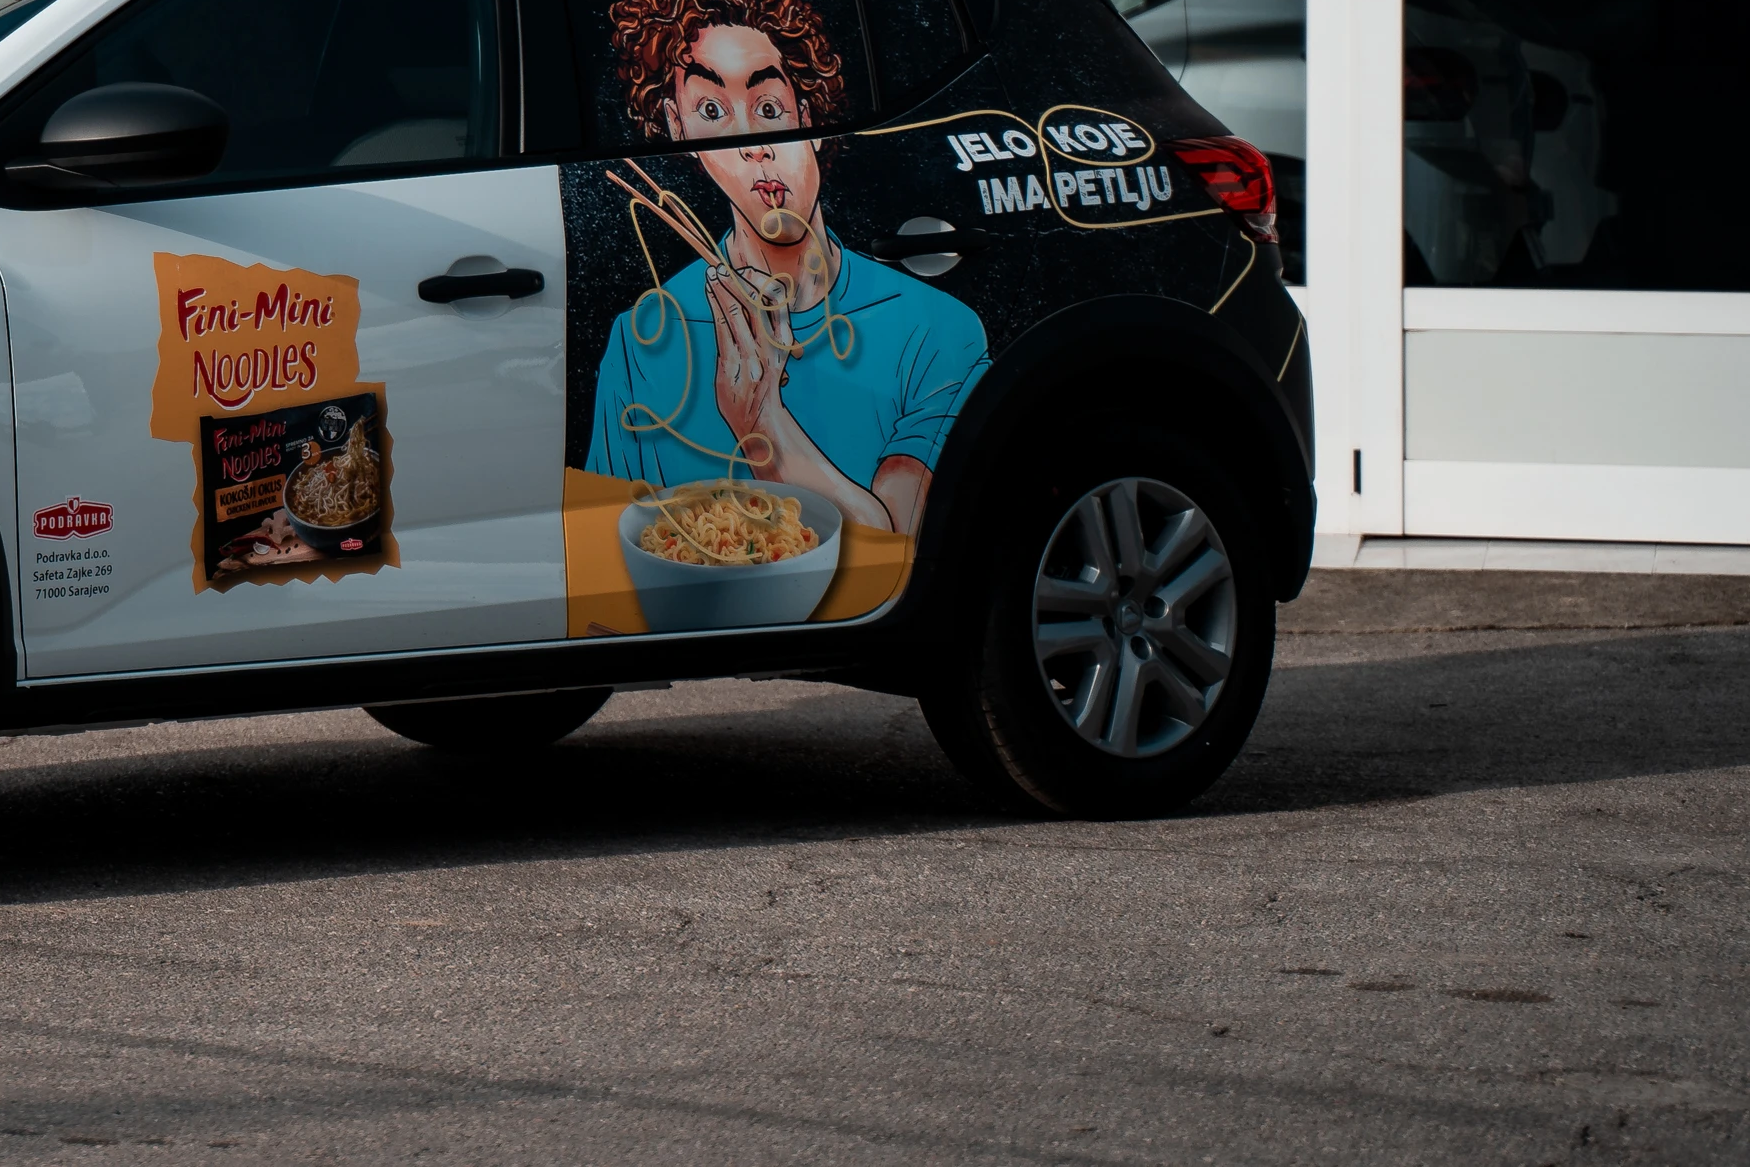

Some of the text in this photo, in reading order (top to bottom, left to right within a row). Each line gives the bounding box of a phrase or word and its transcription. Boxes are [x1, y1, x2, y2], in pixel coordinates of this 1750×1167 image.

[946, 122, 1146, 172] JELO KOJE
[977, 165, 1174, 215] IMA PETLJU
[176, 282, 336, 343] Fini-Mini
[213, 419, 287, 455] Fini-Mini
[301, 442, 311, 460] 3
[220, 479, 282, 507] KOKOŠJI OKUS
[226, 496, 277, 516] CHICKEN FLAVOUR
[40, 512, 107, 531] PODRAVKA
[36, 547, 110, 564] Podravka d.o.o.
[33, 564, 113, 582] Safeta Zajke 269
[35, 584, 110, 600] 71000 Sarajevo
